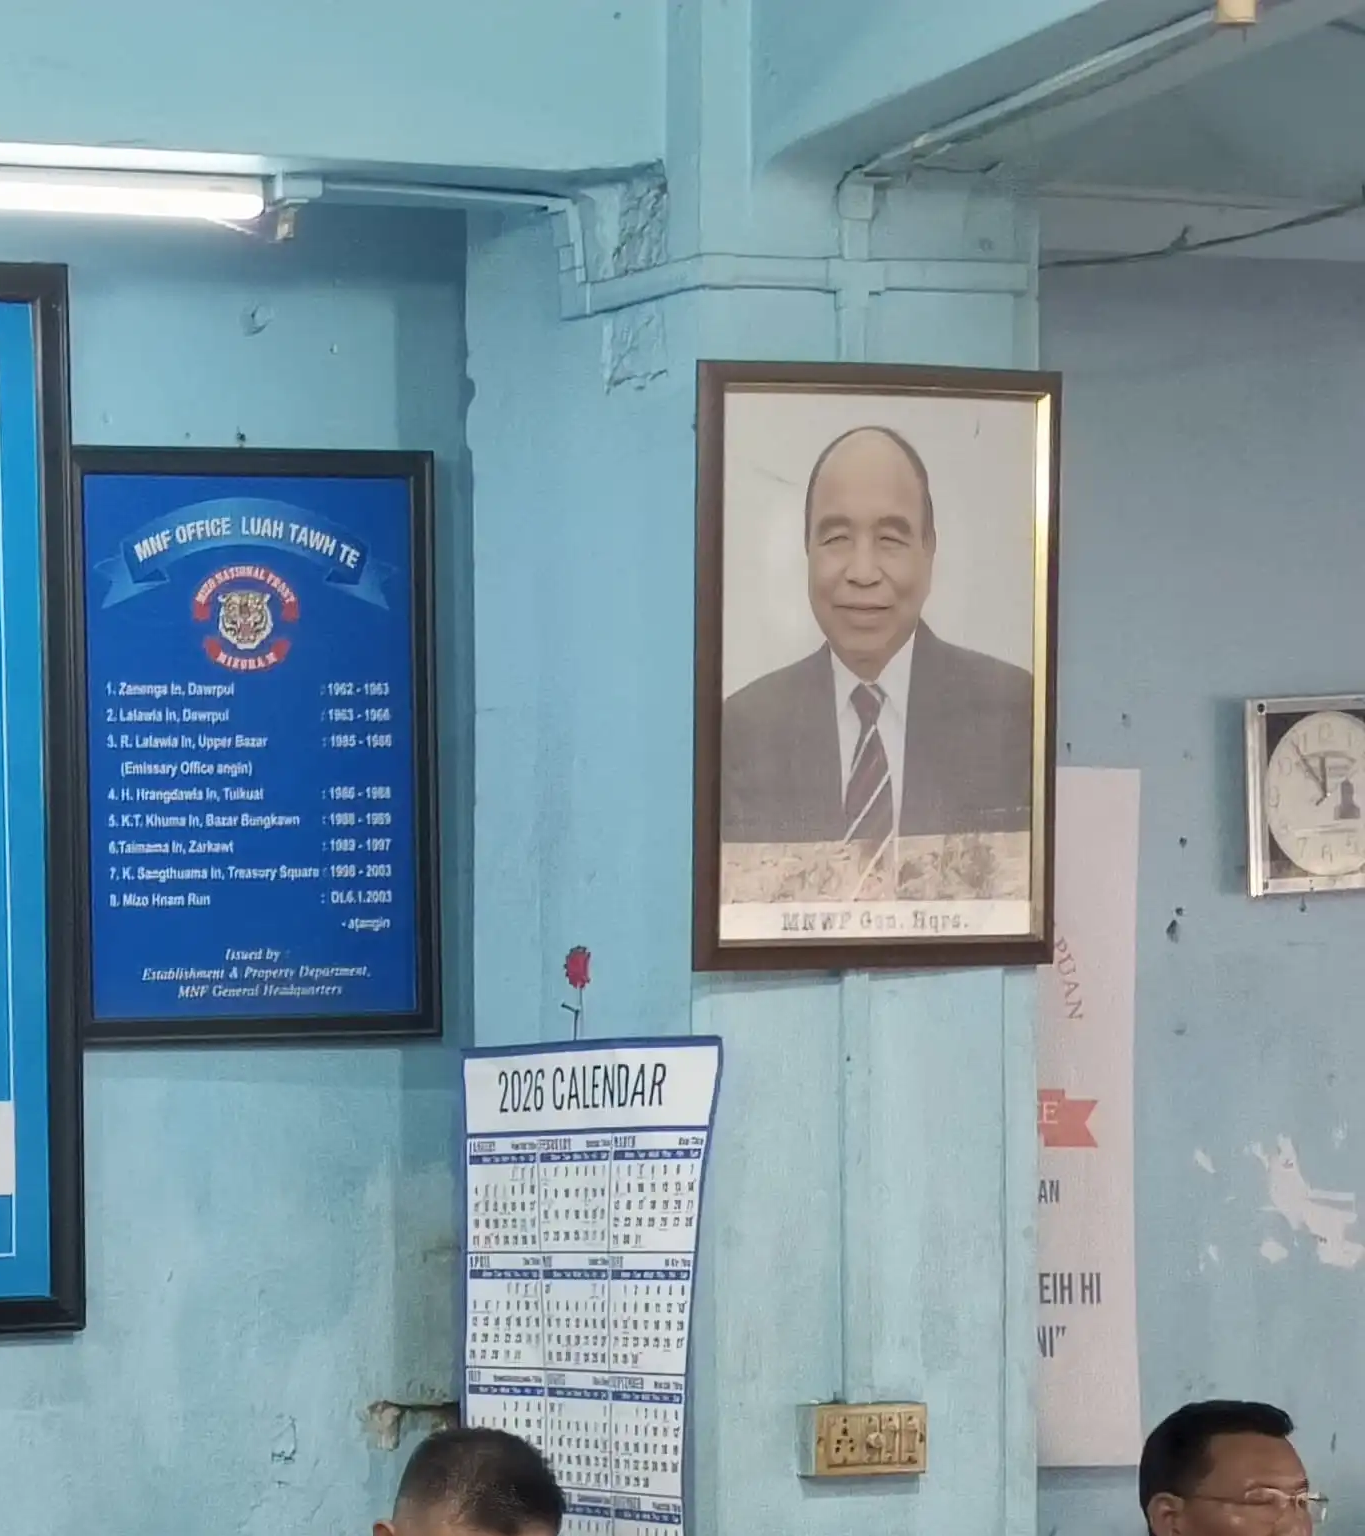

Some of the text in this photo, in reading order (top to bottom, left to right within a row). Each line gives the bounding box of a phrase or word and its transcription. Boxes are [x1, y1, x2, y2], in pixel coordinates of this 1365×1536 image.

[133, 516, 360, 569] MNF OFFICE LUAH TAWH TE
[198, 734, 232, 751] Upper
[180, 761, 214, 776] Office
[123, 893, 149, 907] Mizo
[152, 893, 185, 907] Hnam
[187, 892, 211, 907] Run
[265, 948, 282, 962] by
[177, 985, 210, 999] MNF
[498, 1062, 667, 1114] 2026 CALENDAR
[1080, 1271, 1101, 1304] HI
